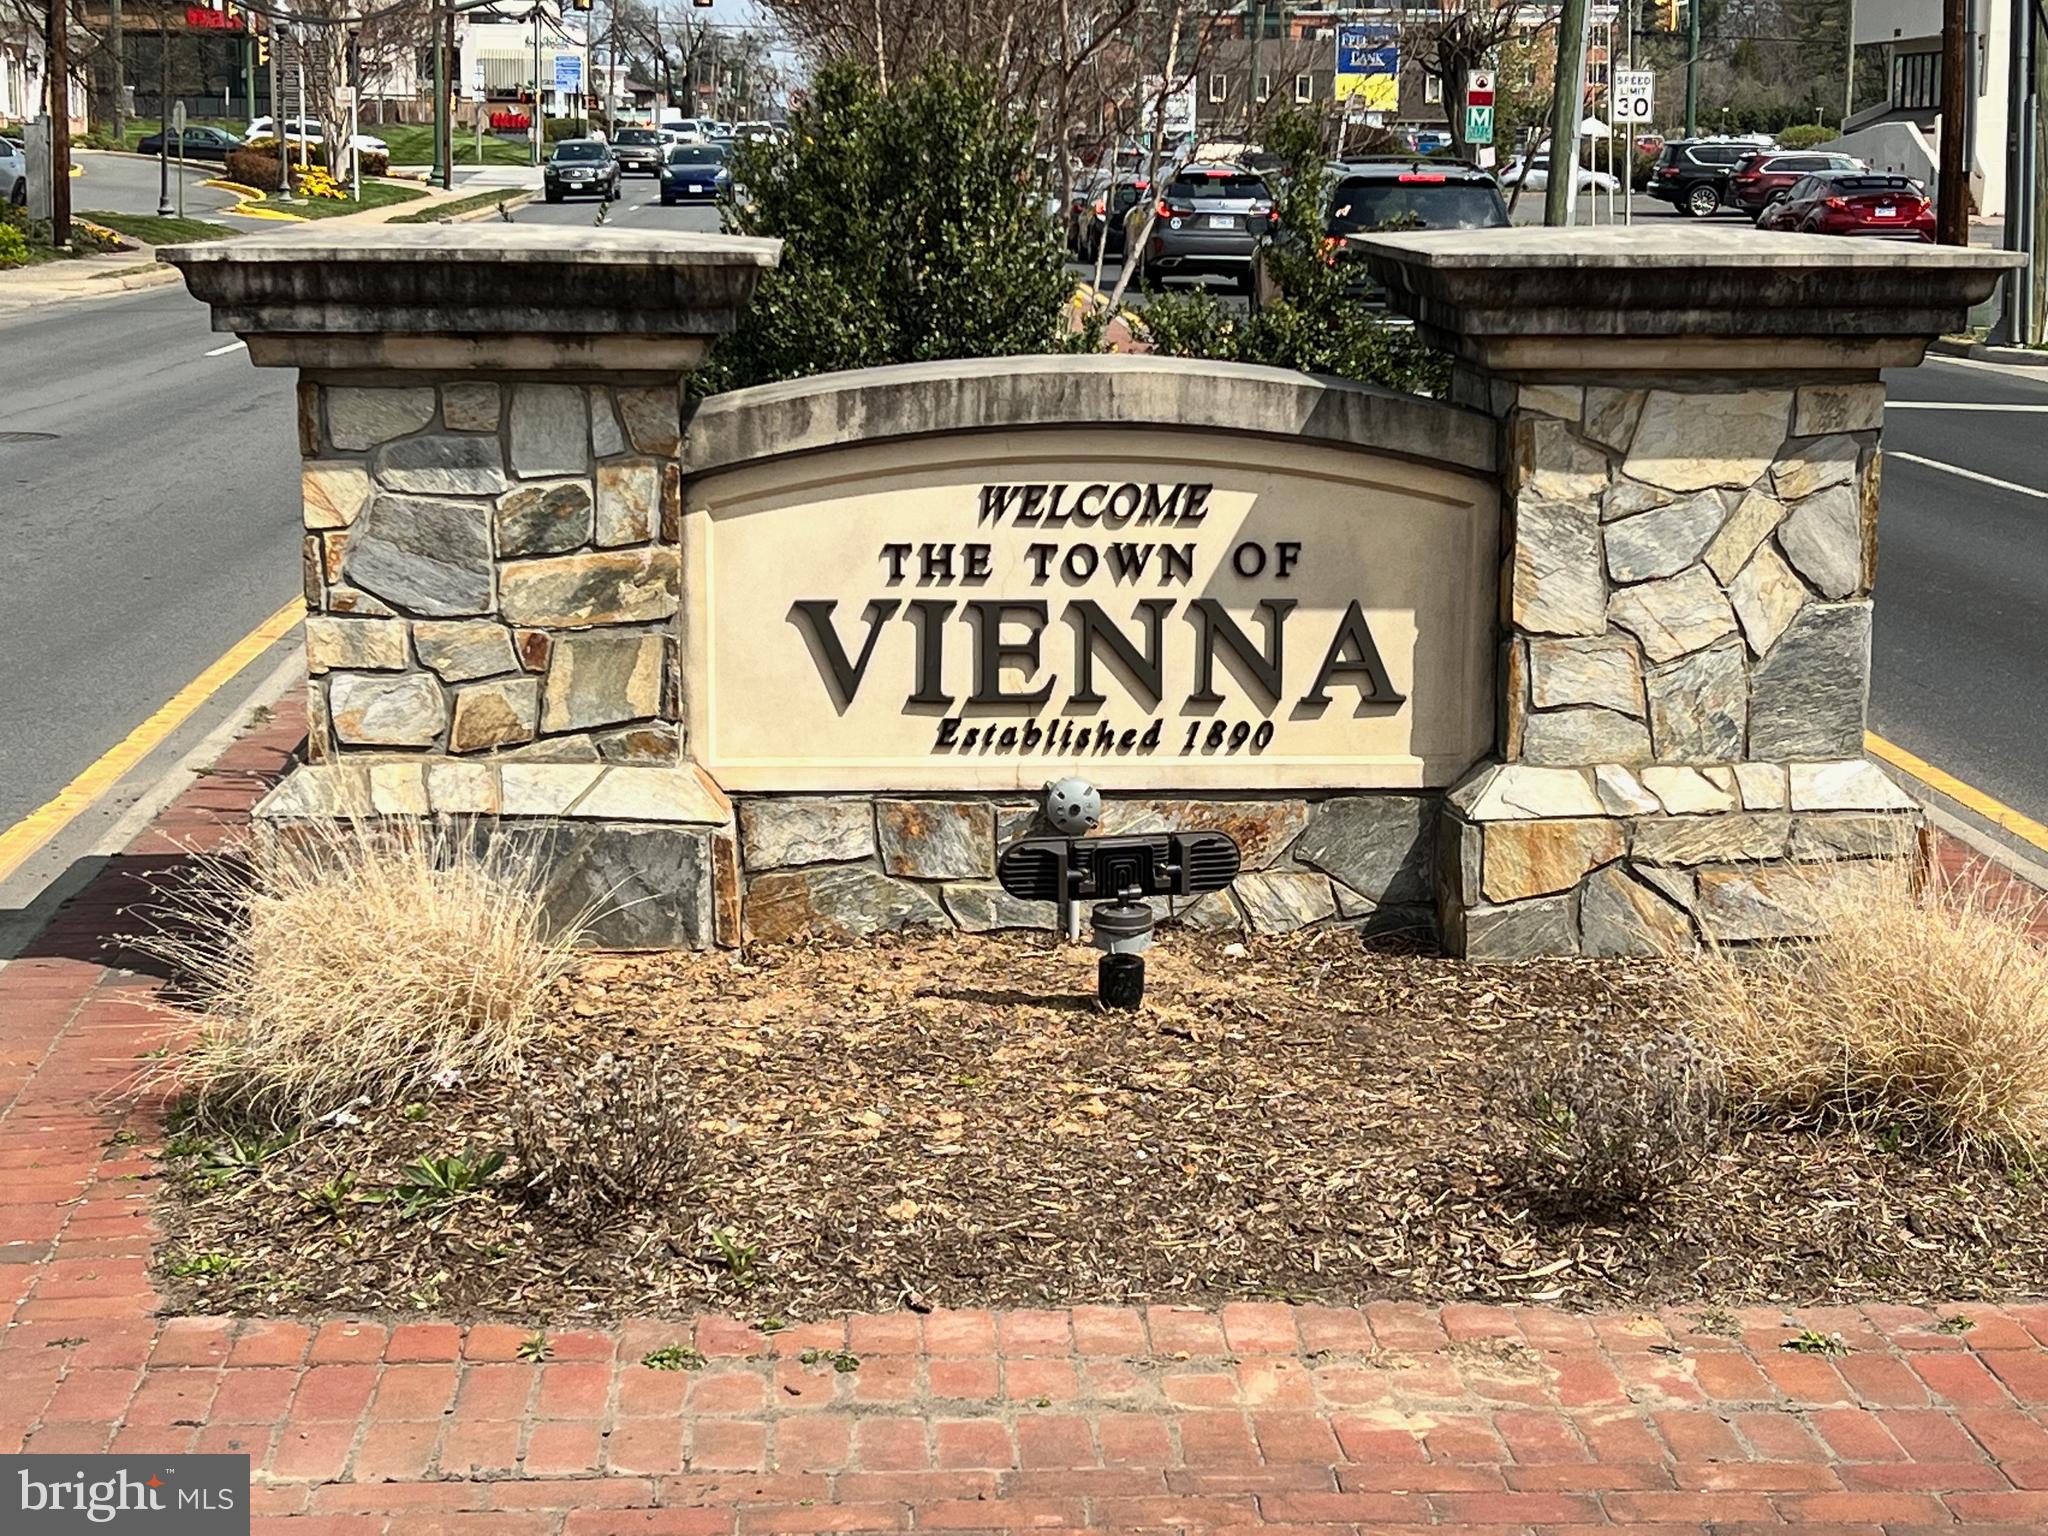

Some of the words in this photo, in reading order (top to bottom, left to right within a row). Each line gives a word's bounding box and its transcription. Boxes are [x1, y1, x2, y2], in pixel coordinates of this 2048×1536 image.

[1617, 76, 1651, 85] SPEED
[1617, 97, 1648, 117] 30
[980, 484, 1212, 524] WELCOME
[882, 543, 993, 582] THE
[1031, 543, 1196, 582] TOWN
[1232, 541, 1302, 578] OF
[787, 599, 1406, 706] VIENNA
[936, 717, 1162, 750] Established
[1187, 719, 1275, 751] 1890
